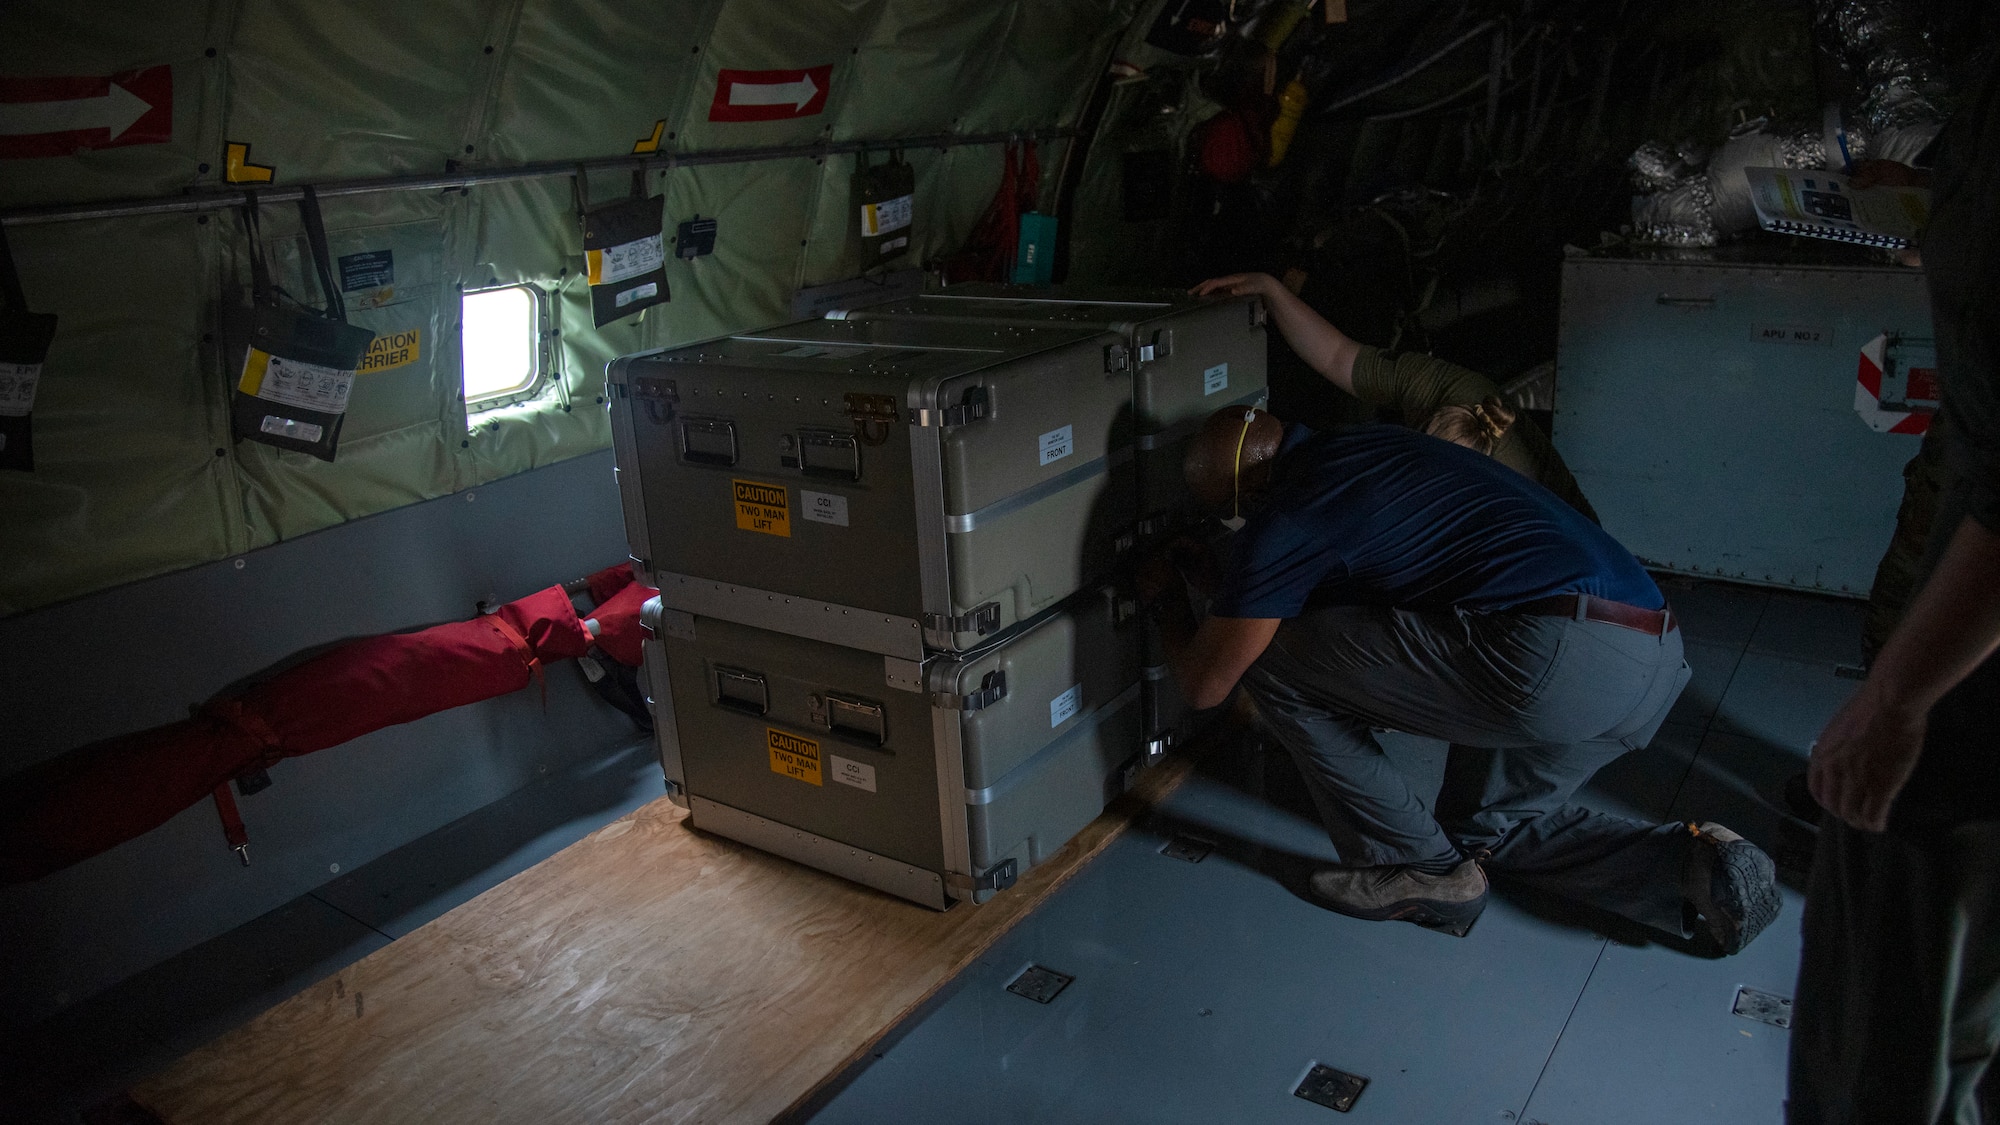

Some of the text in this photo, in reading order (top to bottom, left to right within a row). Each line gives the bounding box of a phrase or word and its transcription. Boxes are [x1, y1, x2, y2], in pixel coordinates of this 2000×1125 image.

[1763, 329, 1820, 341] APU NO 2
[357, 349, 409, 370] RRIER
[1047, 445, 1066, 460] FRONT
[736, 485, 785, 506] CAUTION
[817, 497, 831, 507] CCI
[740, 504, 785, 521] TWO MAN
[753, 519, 772, 531] LIFT
[770, 733, 817, 758] CAUTION
[773, 750, 817, 771] TWO MAN
[786, 765, 805, 778] LIFT
[846, 763, 860, 774] CCI
